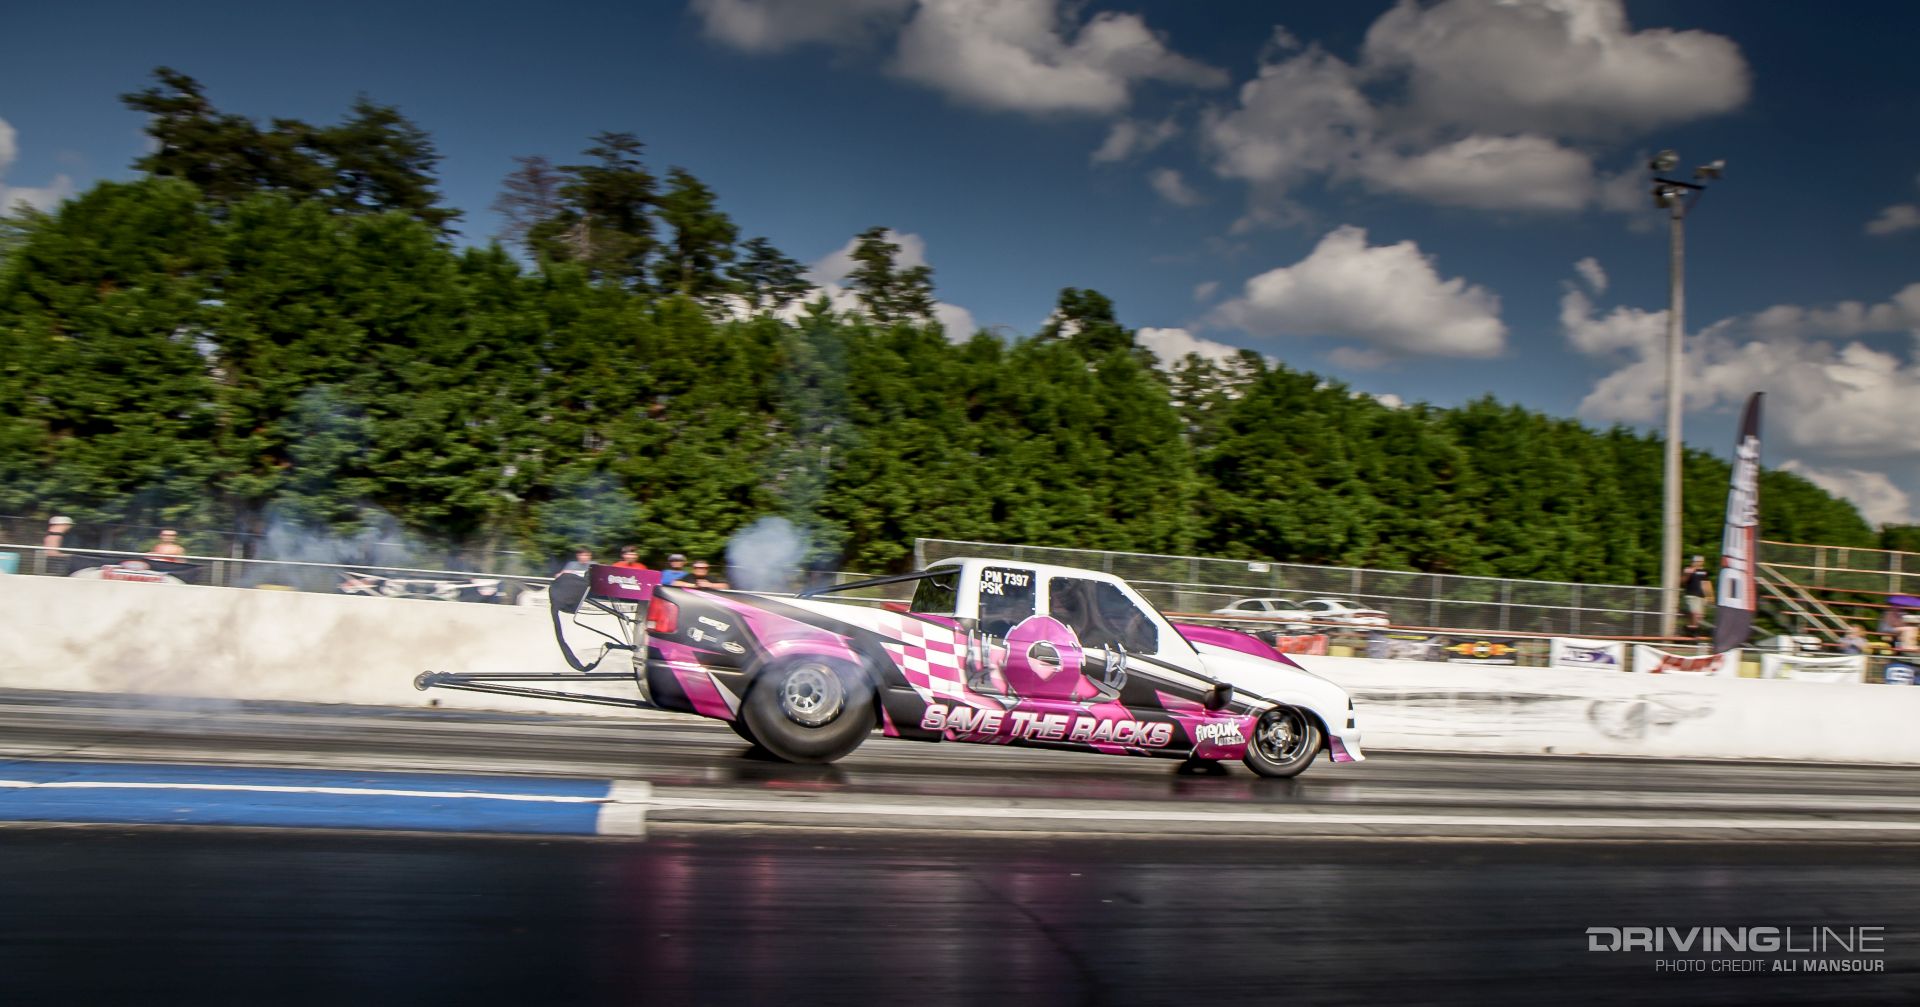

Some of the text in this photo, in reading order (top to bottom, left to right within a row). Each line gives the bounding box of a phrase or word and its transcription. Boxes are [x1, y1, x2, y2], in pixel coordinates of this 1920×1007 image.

[980, 580, 1004, 596] PSK
[984, 570, 1030, 587] PM 7397
[921, 704, 1174, 747] SAVE THE RACKS
[1195, 717, 1243, 745] firepunk
